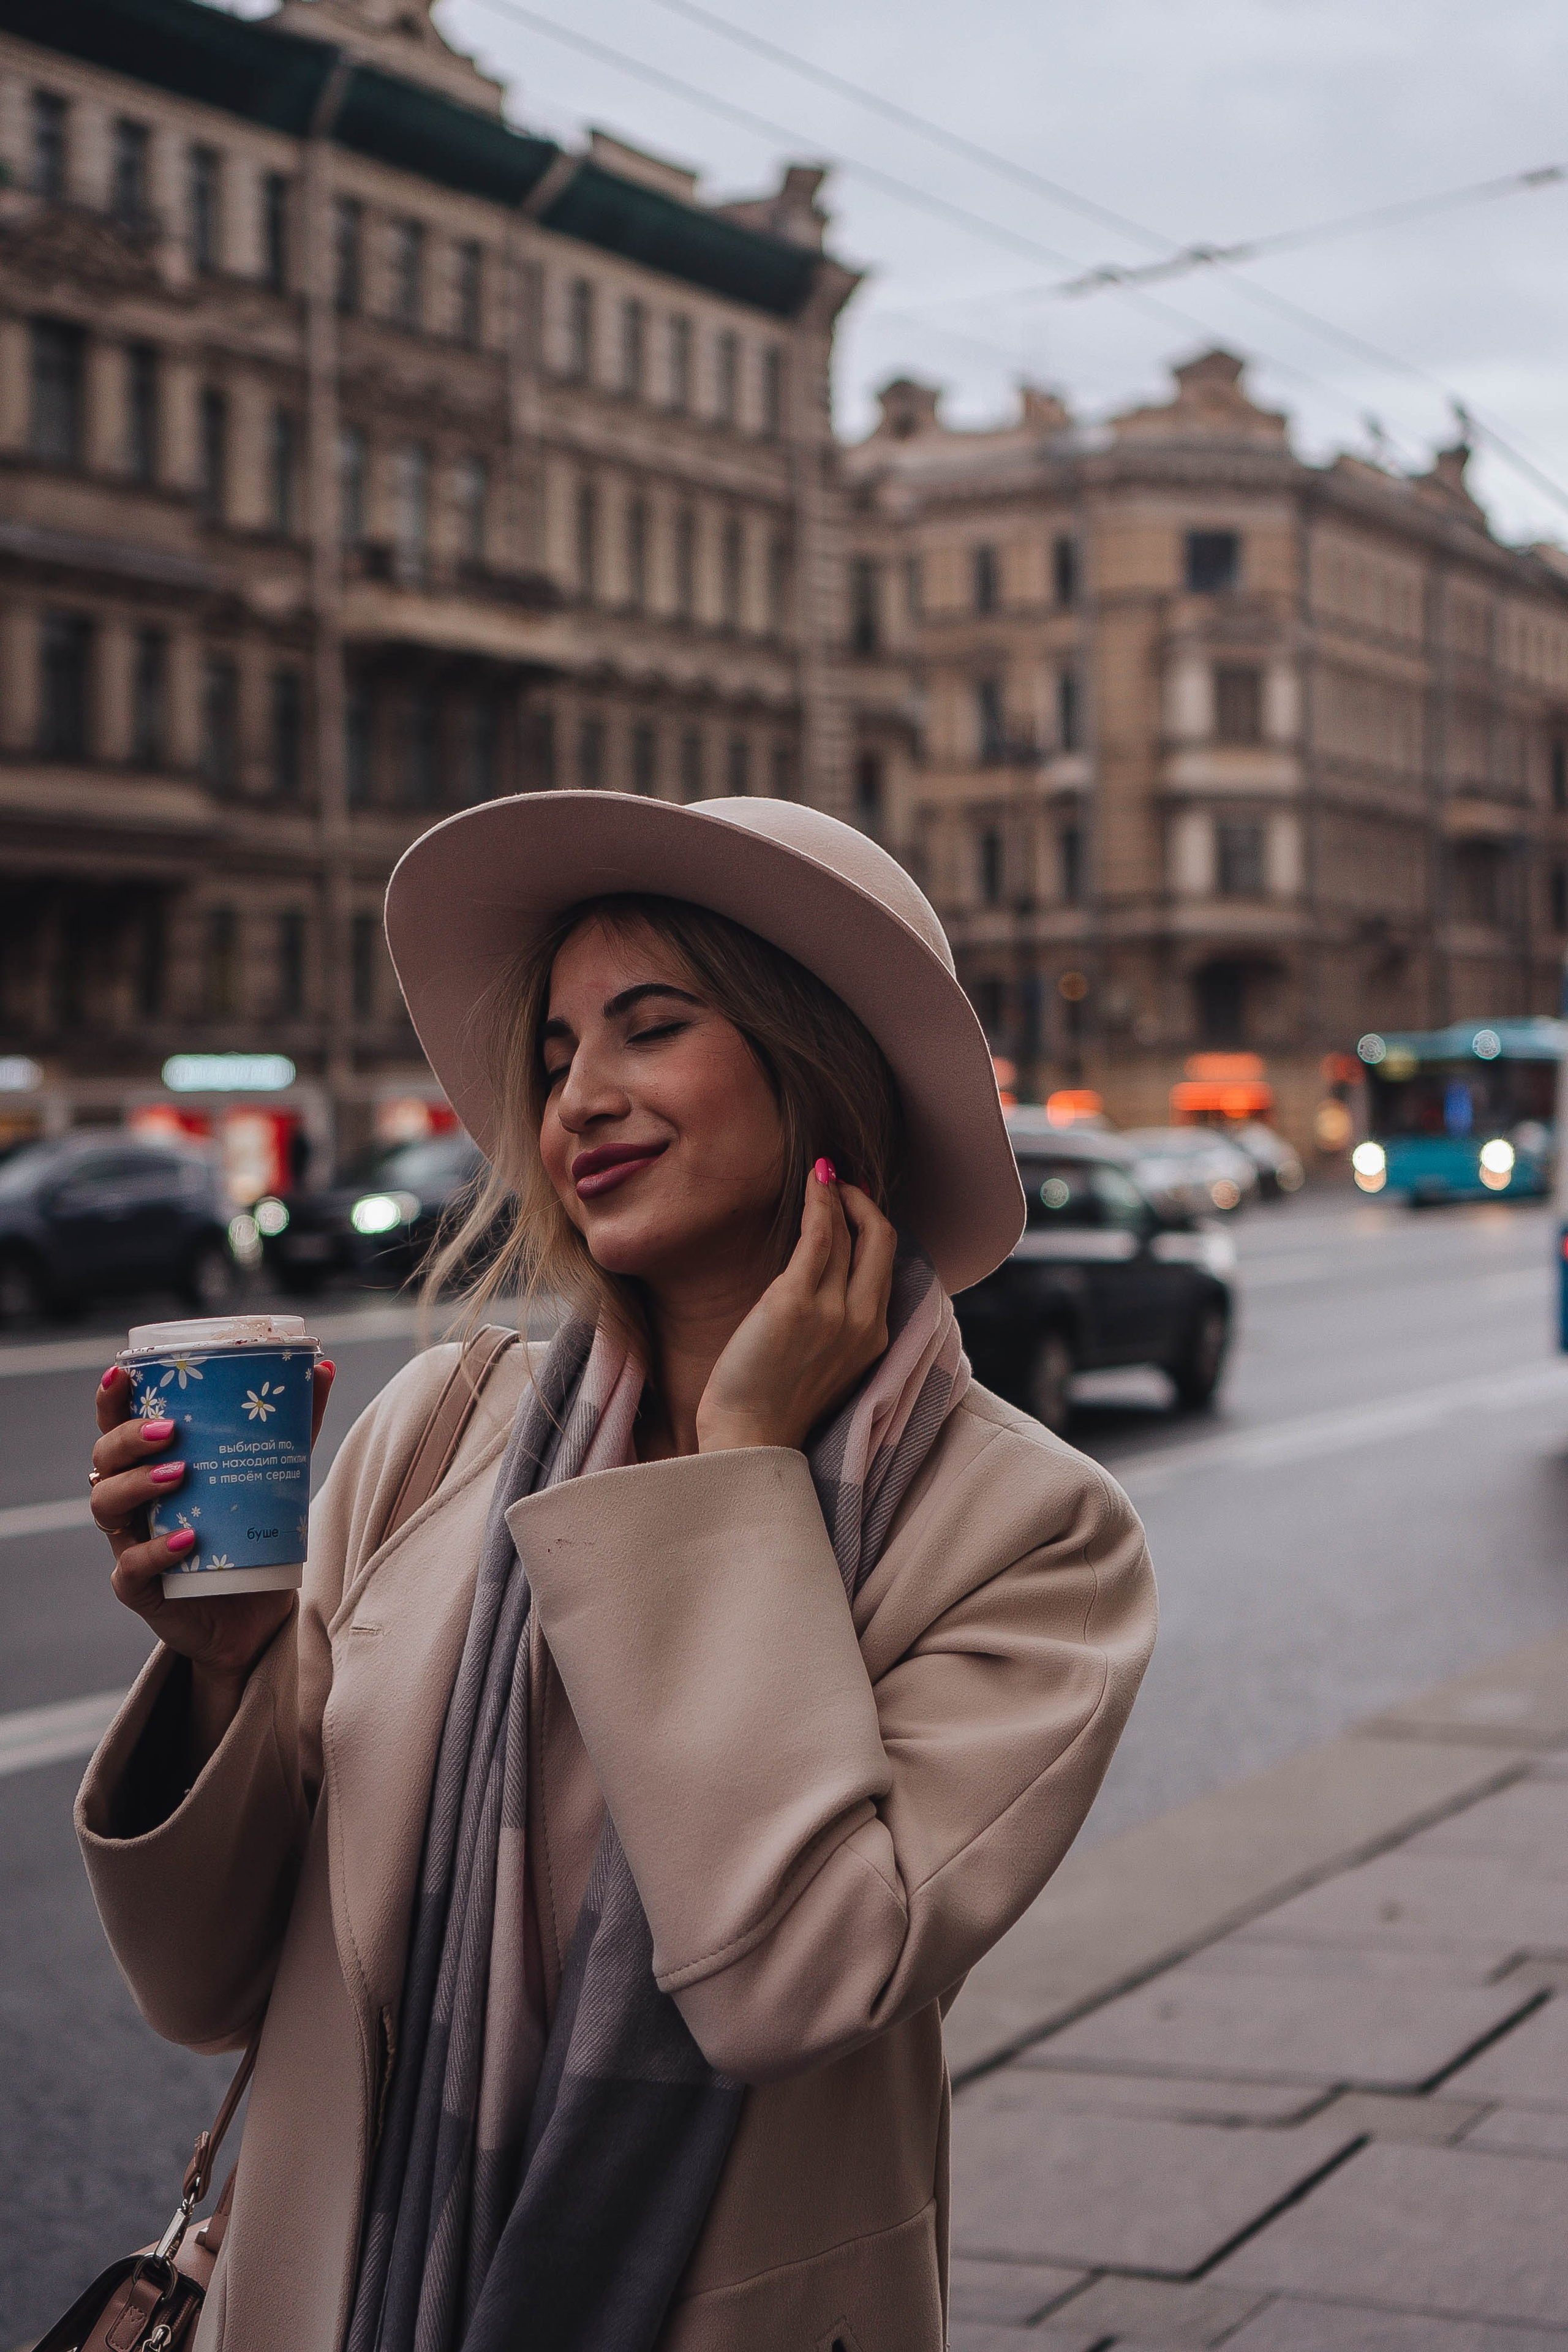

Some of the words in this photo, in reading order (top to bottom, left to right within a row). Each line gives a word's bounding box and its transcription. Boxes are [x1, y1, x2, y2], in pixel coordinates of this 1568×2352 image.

[219, 1439, 276, 1454] выбирай
[278, 1441, 295, 1450] то,
[193, 1461, 218, 1470] что
[222, 1456, 278, 1468] находит
[209, 1476, 216, 1485] в
[221, 1471, 262, 1483] твоём
[266, 1470, 300, 1482] сердце
[247, 1528, 279, 1542] буше
